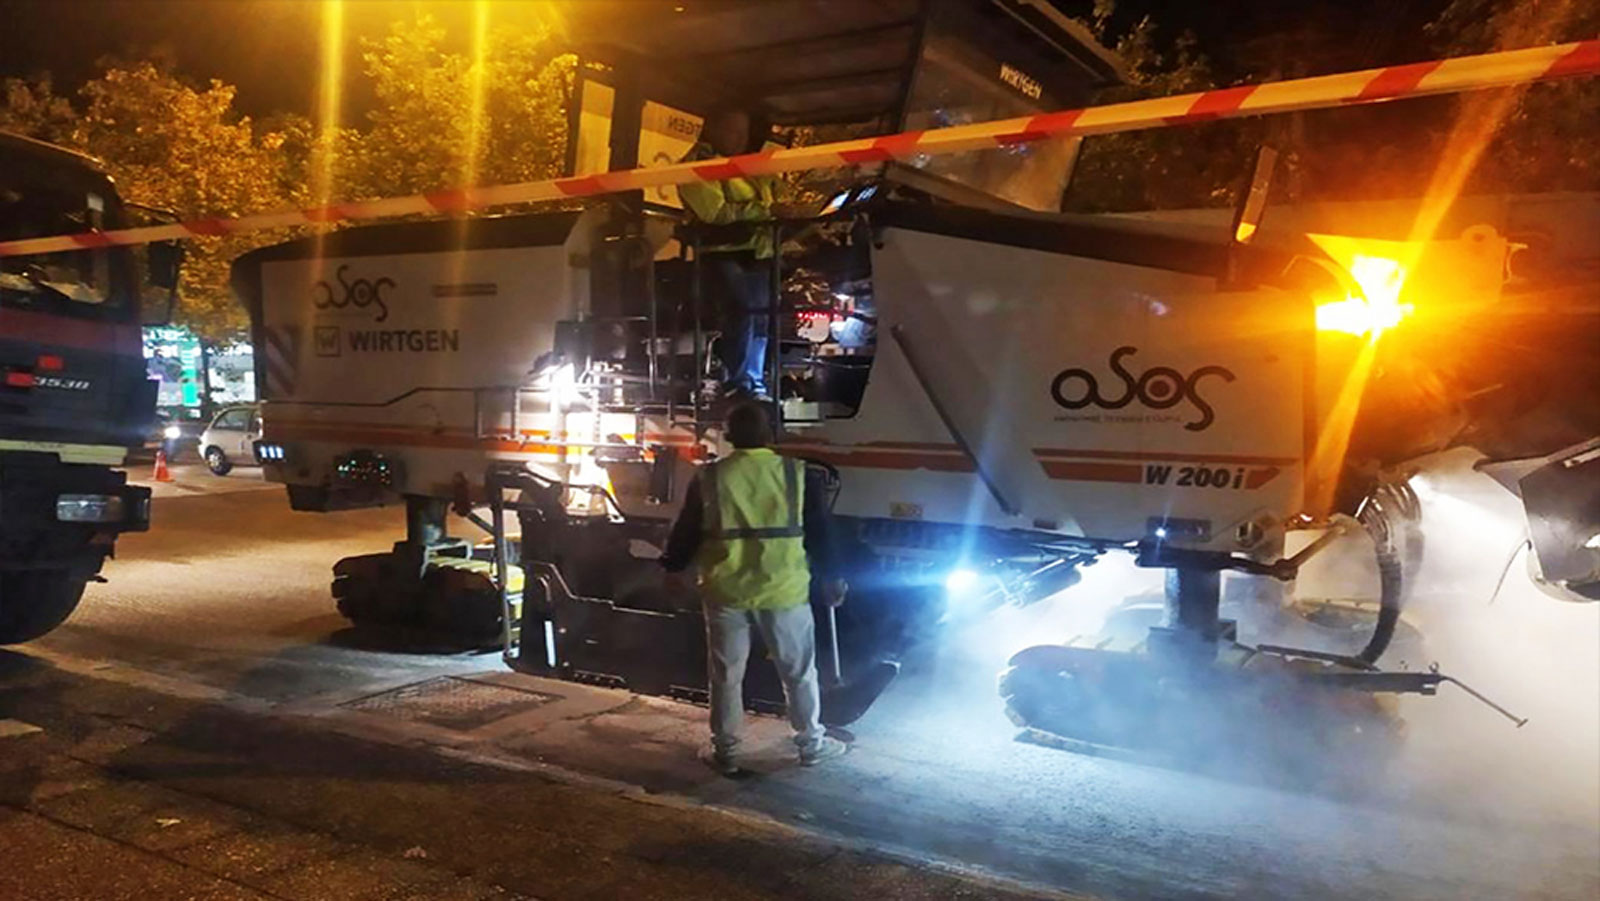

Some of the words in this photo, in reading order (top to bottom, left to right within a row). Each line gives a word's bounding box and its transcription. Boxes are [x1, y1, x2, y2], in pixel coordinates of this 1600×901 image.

[1000, 63, 1042, 99] WIRTGEN
[350, 329, 460, 352] WIRTGEN
[1145, 464, 1172, 485] W
